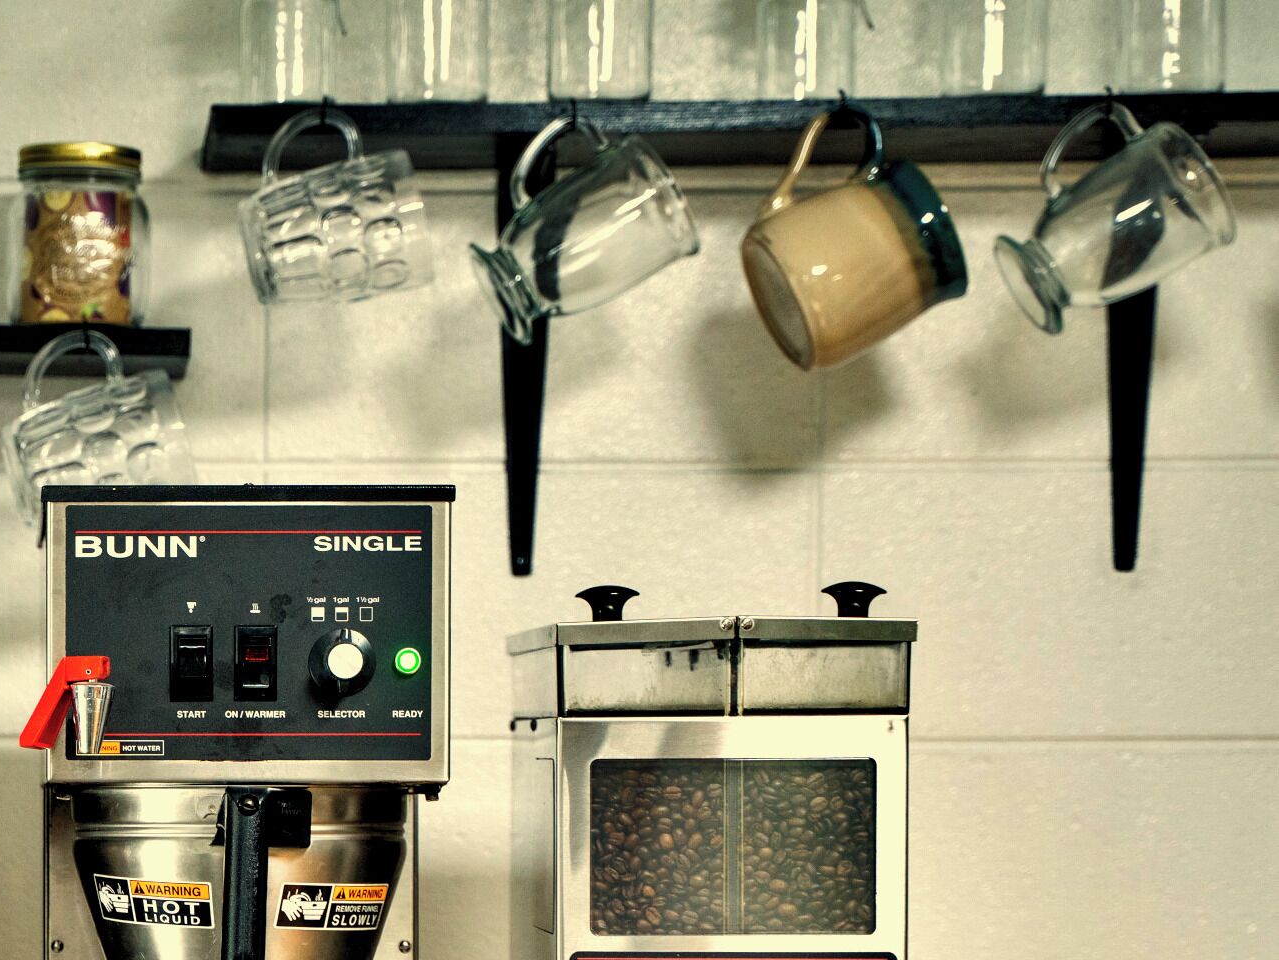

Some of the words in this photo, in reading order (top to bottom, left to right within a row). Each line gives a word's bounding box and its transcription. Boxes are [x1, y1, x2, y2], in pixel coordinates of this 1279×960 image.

[75, 536, 198, 558] BUNN
[313, 536, 422, 552] SINGLE
[176, 710, 206, 719] START
[317, 710, 366, 719] SELECTOR
[392, 710, 423, 719] READY
[144, 884, 201, 898] WARNING
[348, 888, 383, 900] WARNING
[142, 899, 200, 916] HOT
[335, 905, 360, 913] REMOVE
[361, 905, 379, 913] FUNNEL
[144, 913, 201, 925] LIQUID
[332, 914, 378, 927] SLOWLY
